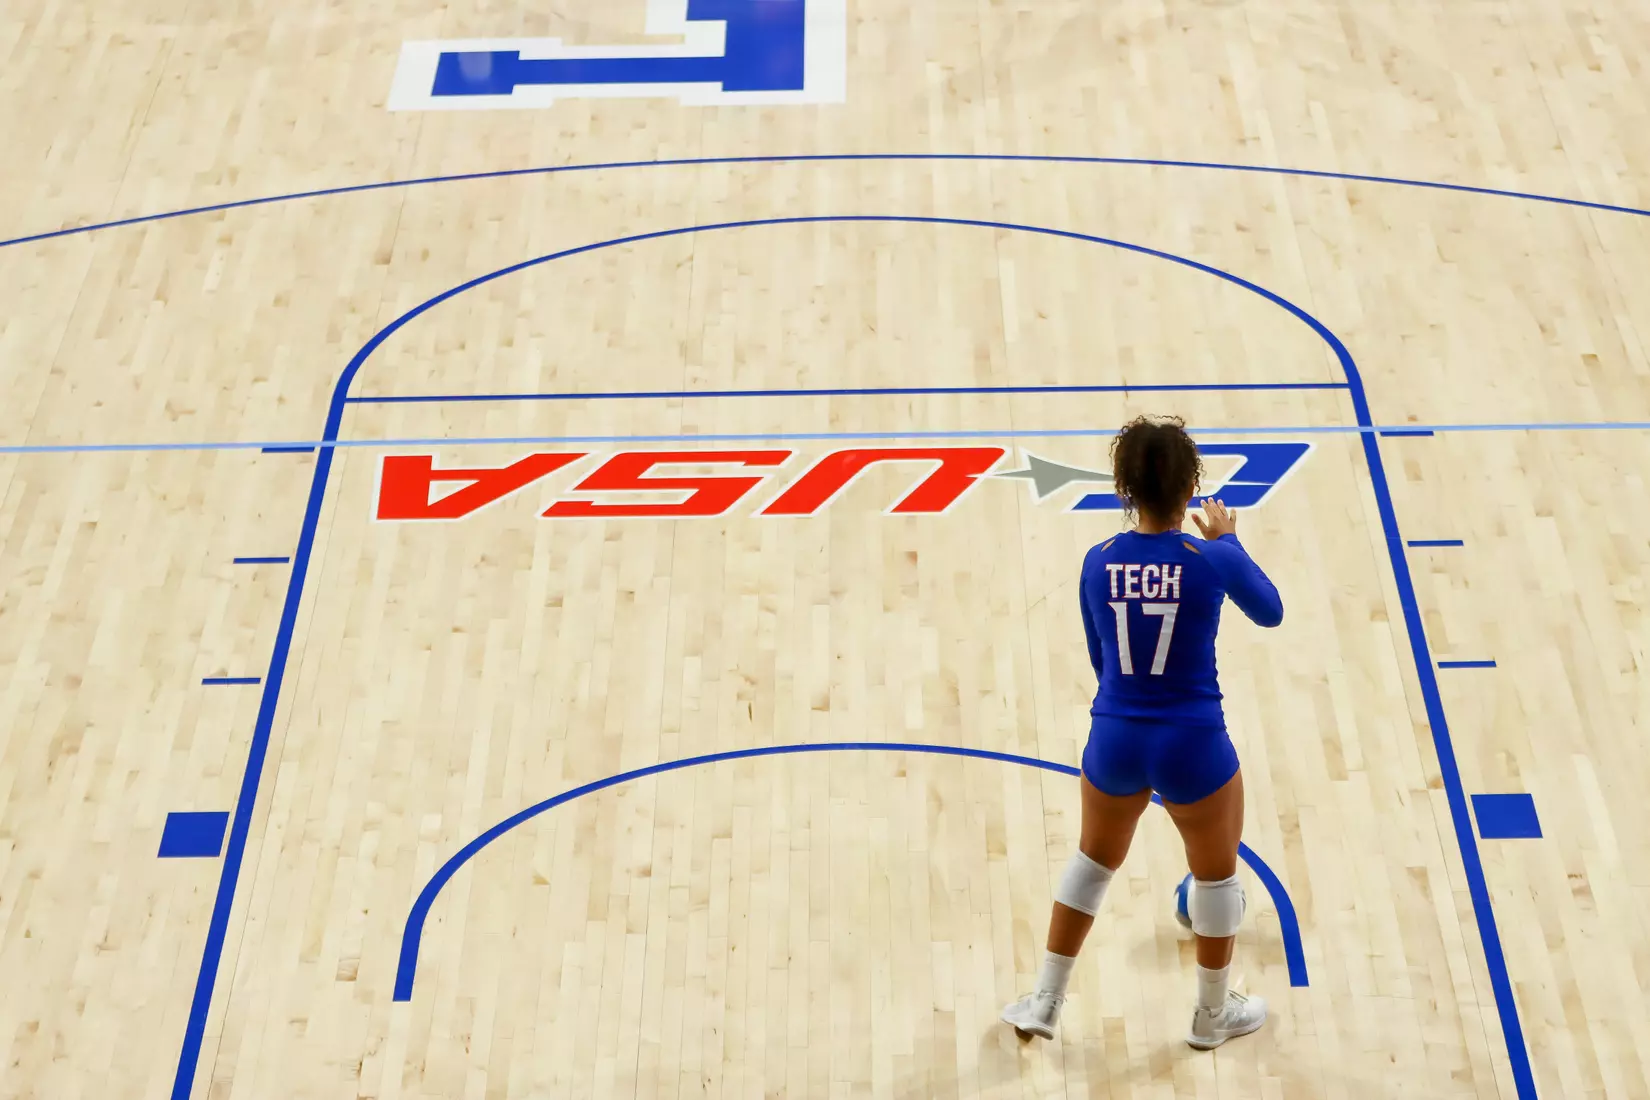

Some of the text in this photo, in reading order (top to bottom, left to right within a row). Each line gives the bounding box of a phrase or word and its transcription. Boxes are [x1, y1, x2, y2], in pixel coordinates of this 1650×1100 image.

[375, 446, 1006, 521] USA
[1105, 563, 1183, 599] TECH
[1107, 601, 1180, 675] 17
